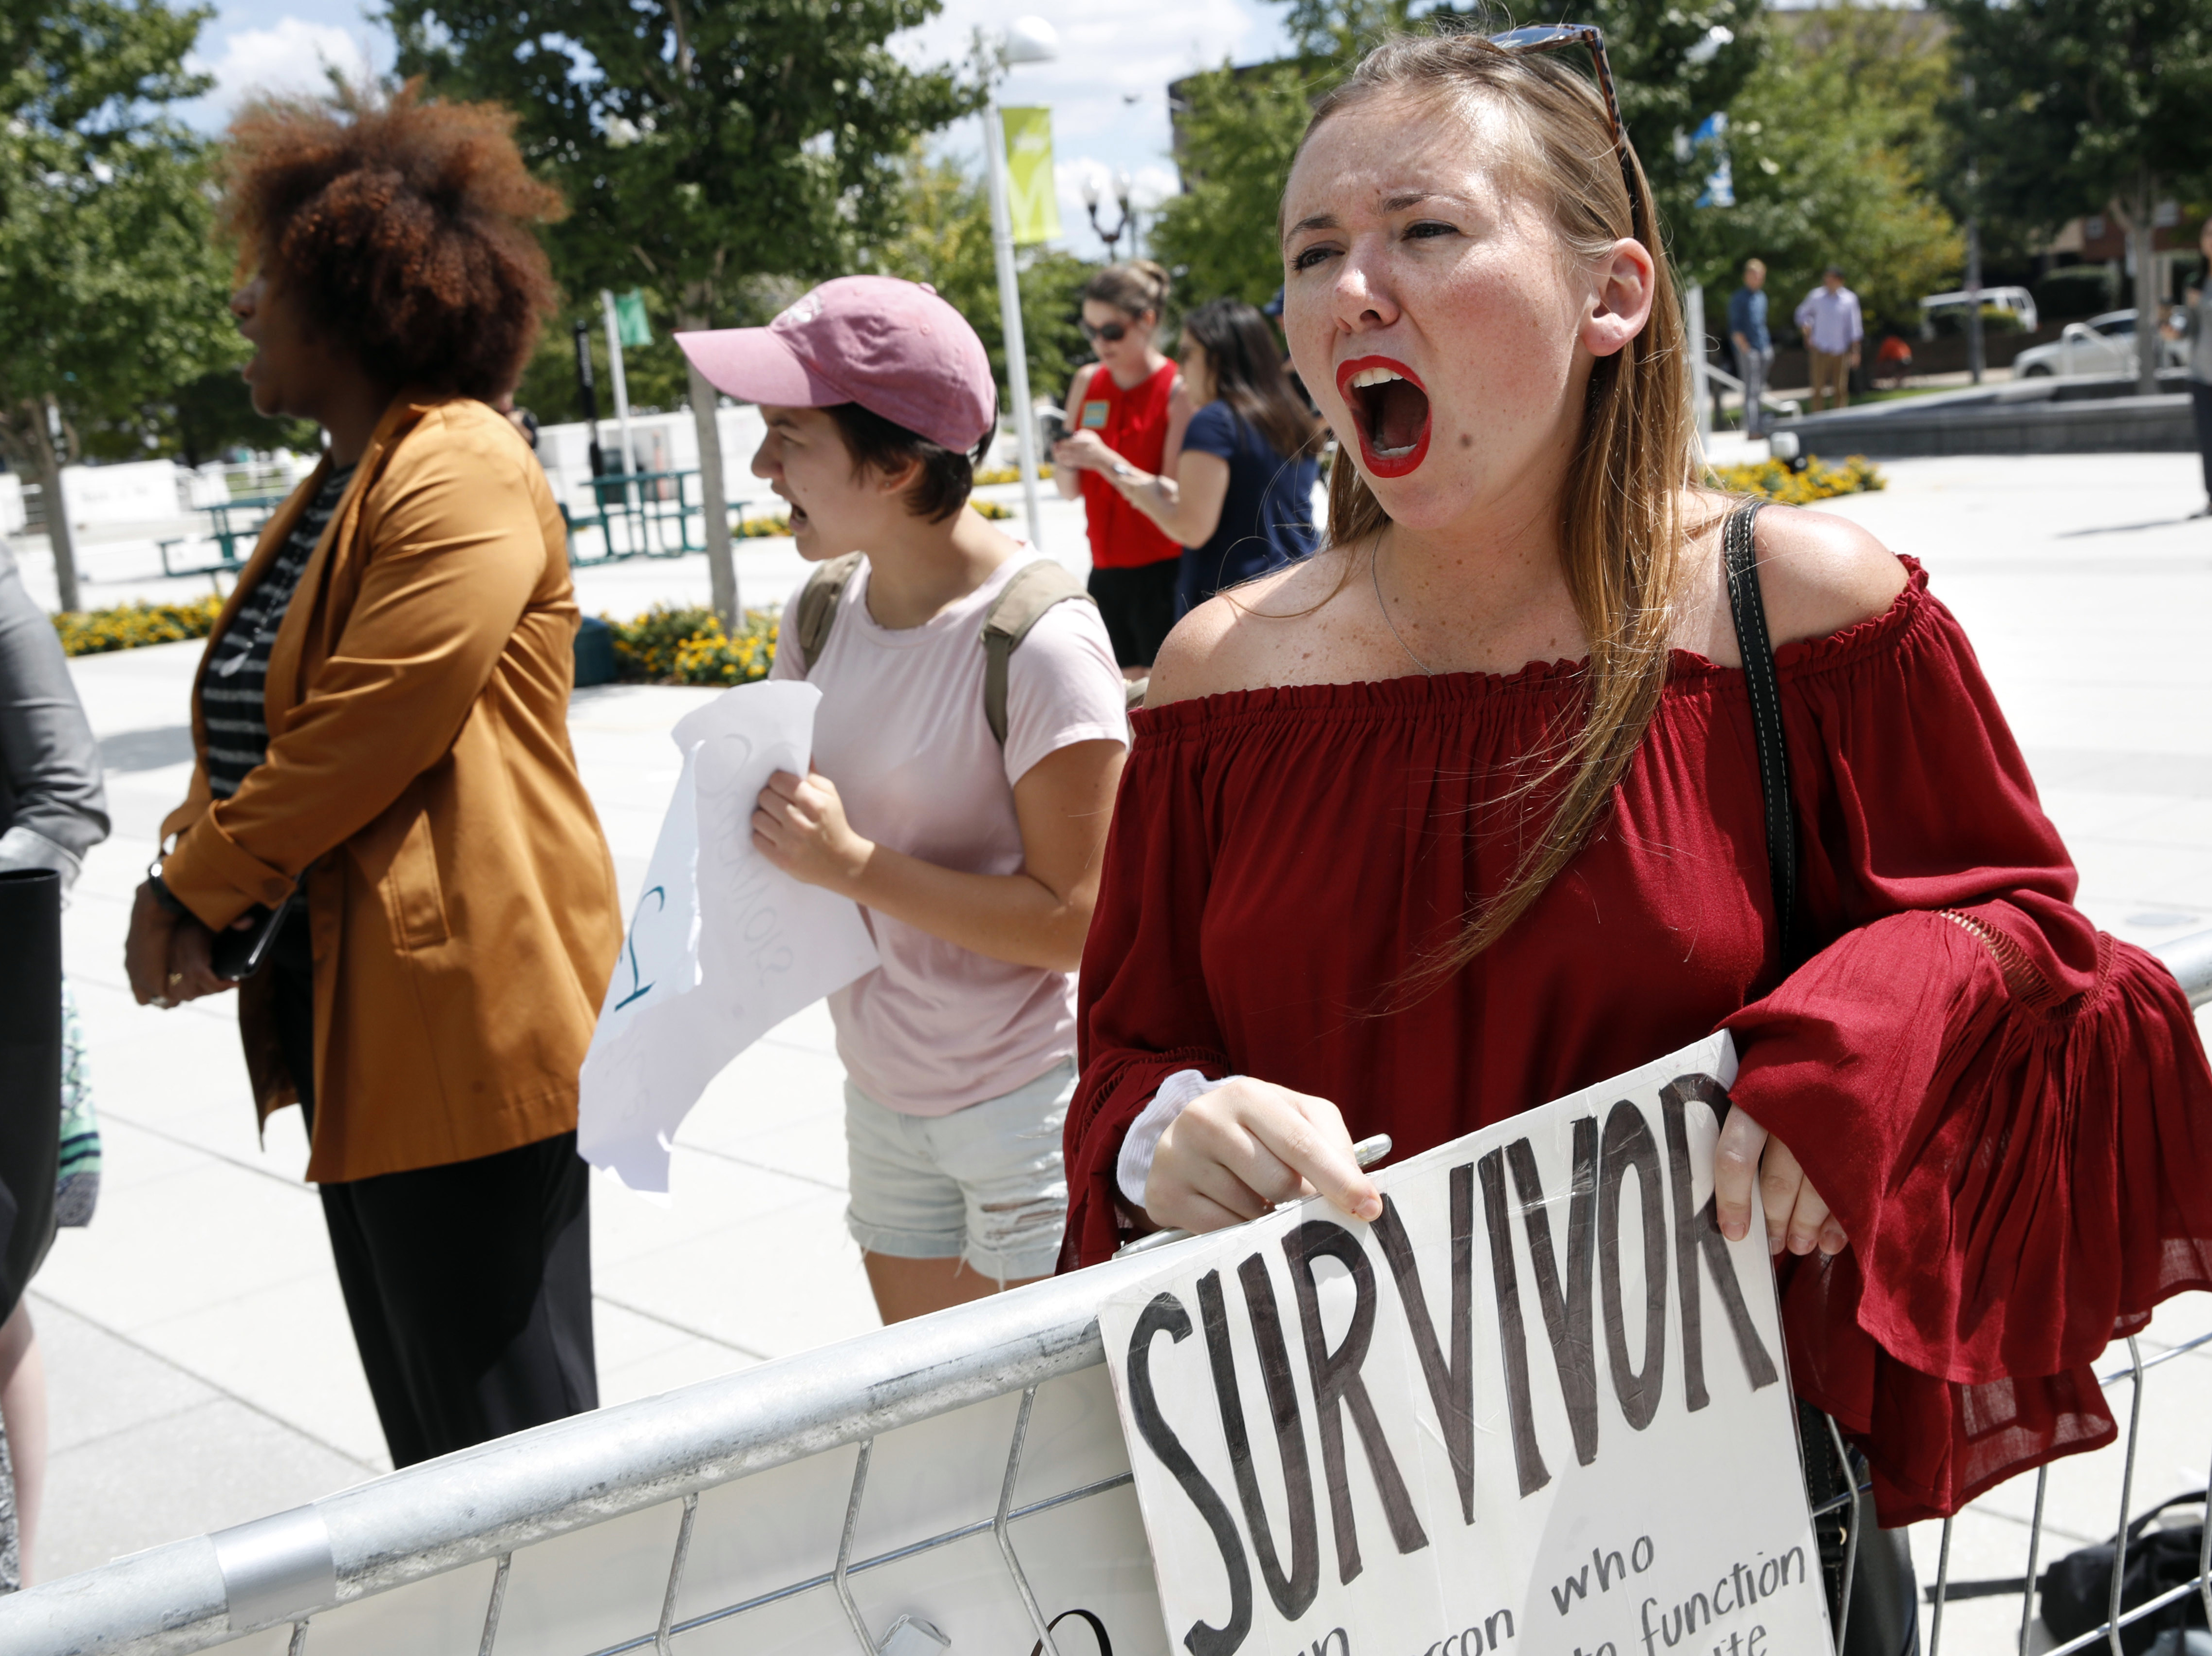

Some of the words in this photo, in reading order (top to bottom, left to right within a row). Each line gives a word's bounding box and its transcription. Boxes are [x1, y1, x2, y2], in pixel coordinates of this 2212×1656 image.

[1127, 1073, 1779, 1656] SURVIVOR
[1551, 1535, 1654, 1616] who
[1641, 1546, 1805, 1656] function
